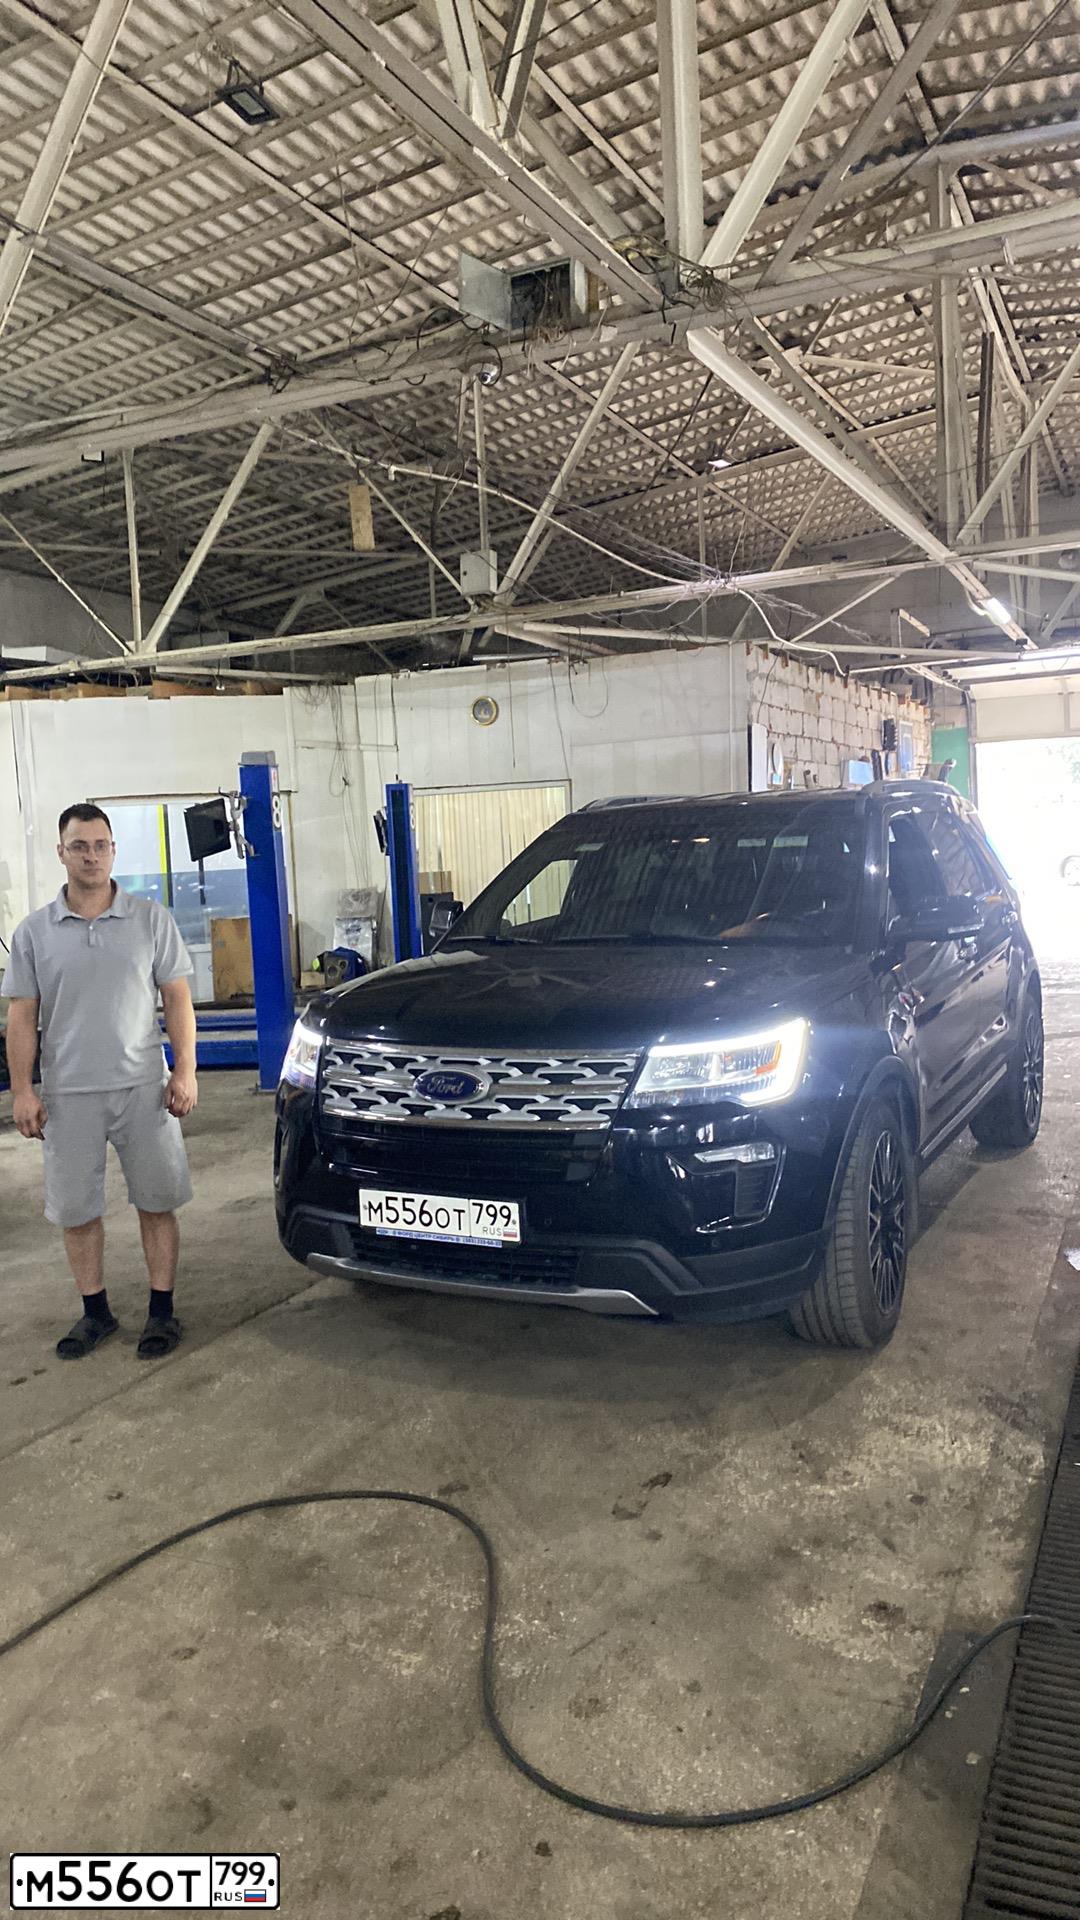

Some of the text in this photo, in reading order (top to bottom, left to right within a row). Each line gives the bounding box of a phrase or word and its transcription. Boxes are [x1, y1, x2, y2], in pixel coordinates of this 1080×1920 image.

[426, 1075, 465, 1094] Ford
[472, 1202, 512, 1227] 799
[482, 1226, 502, 1236] RUS
